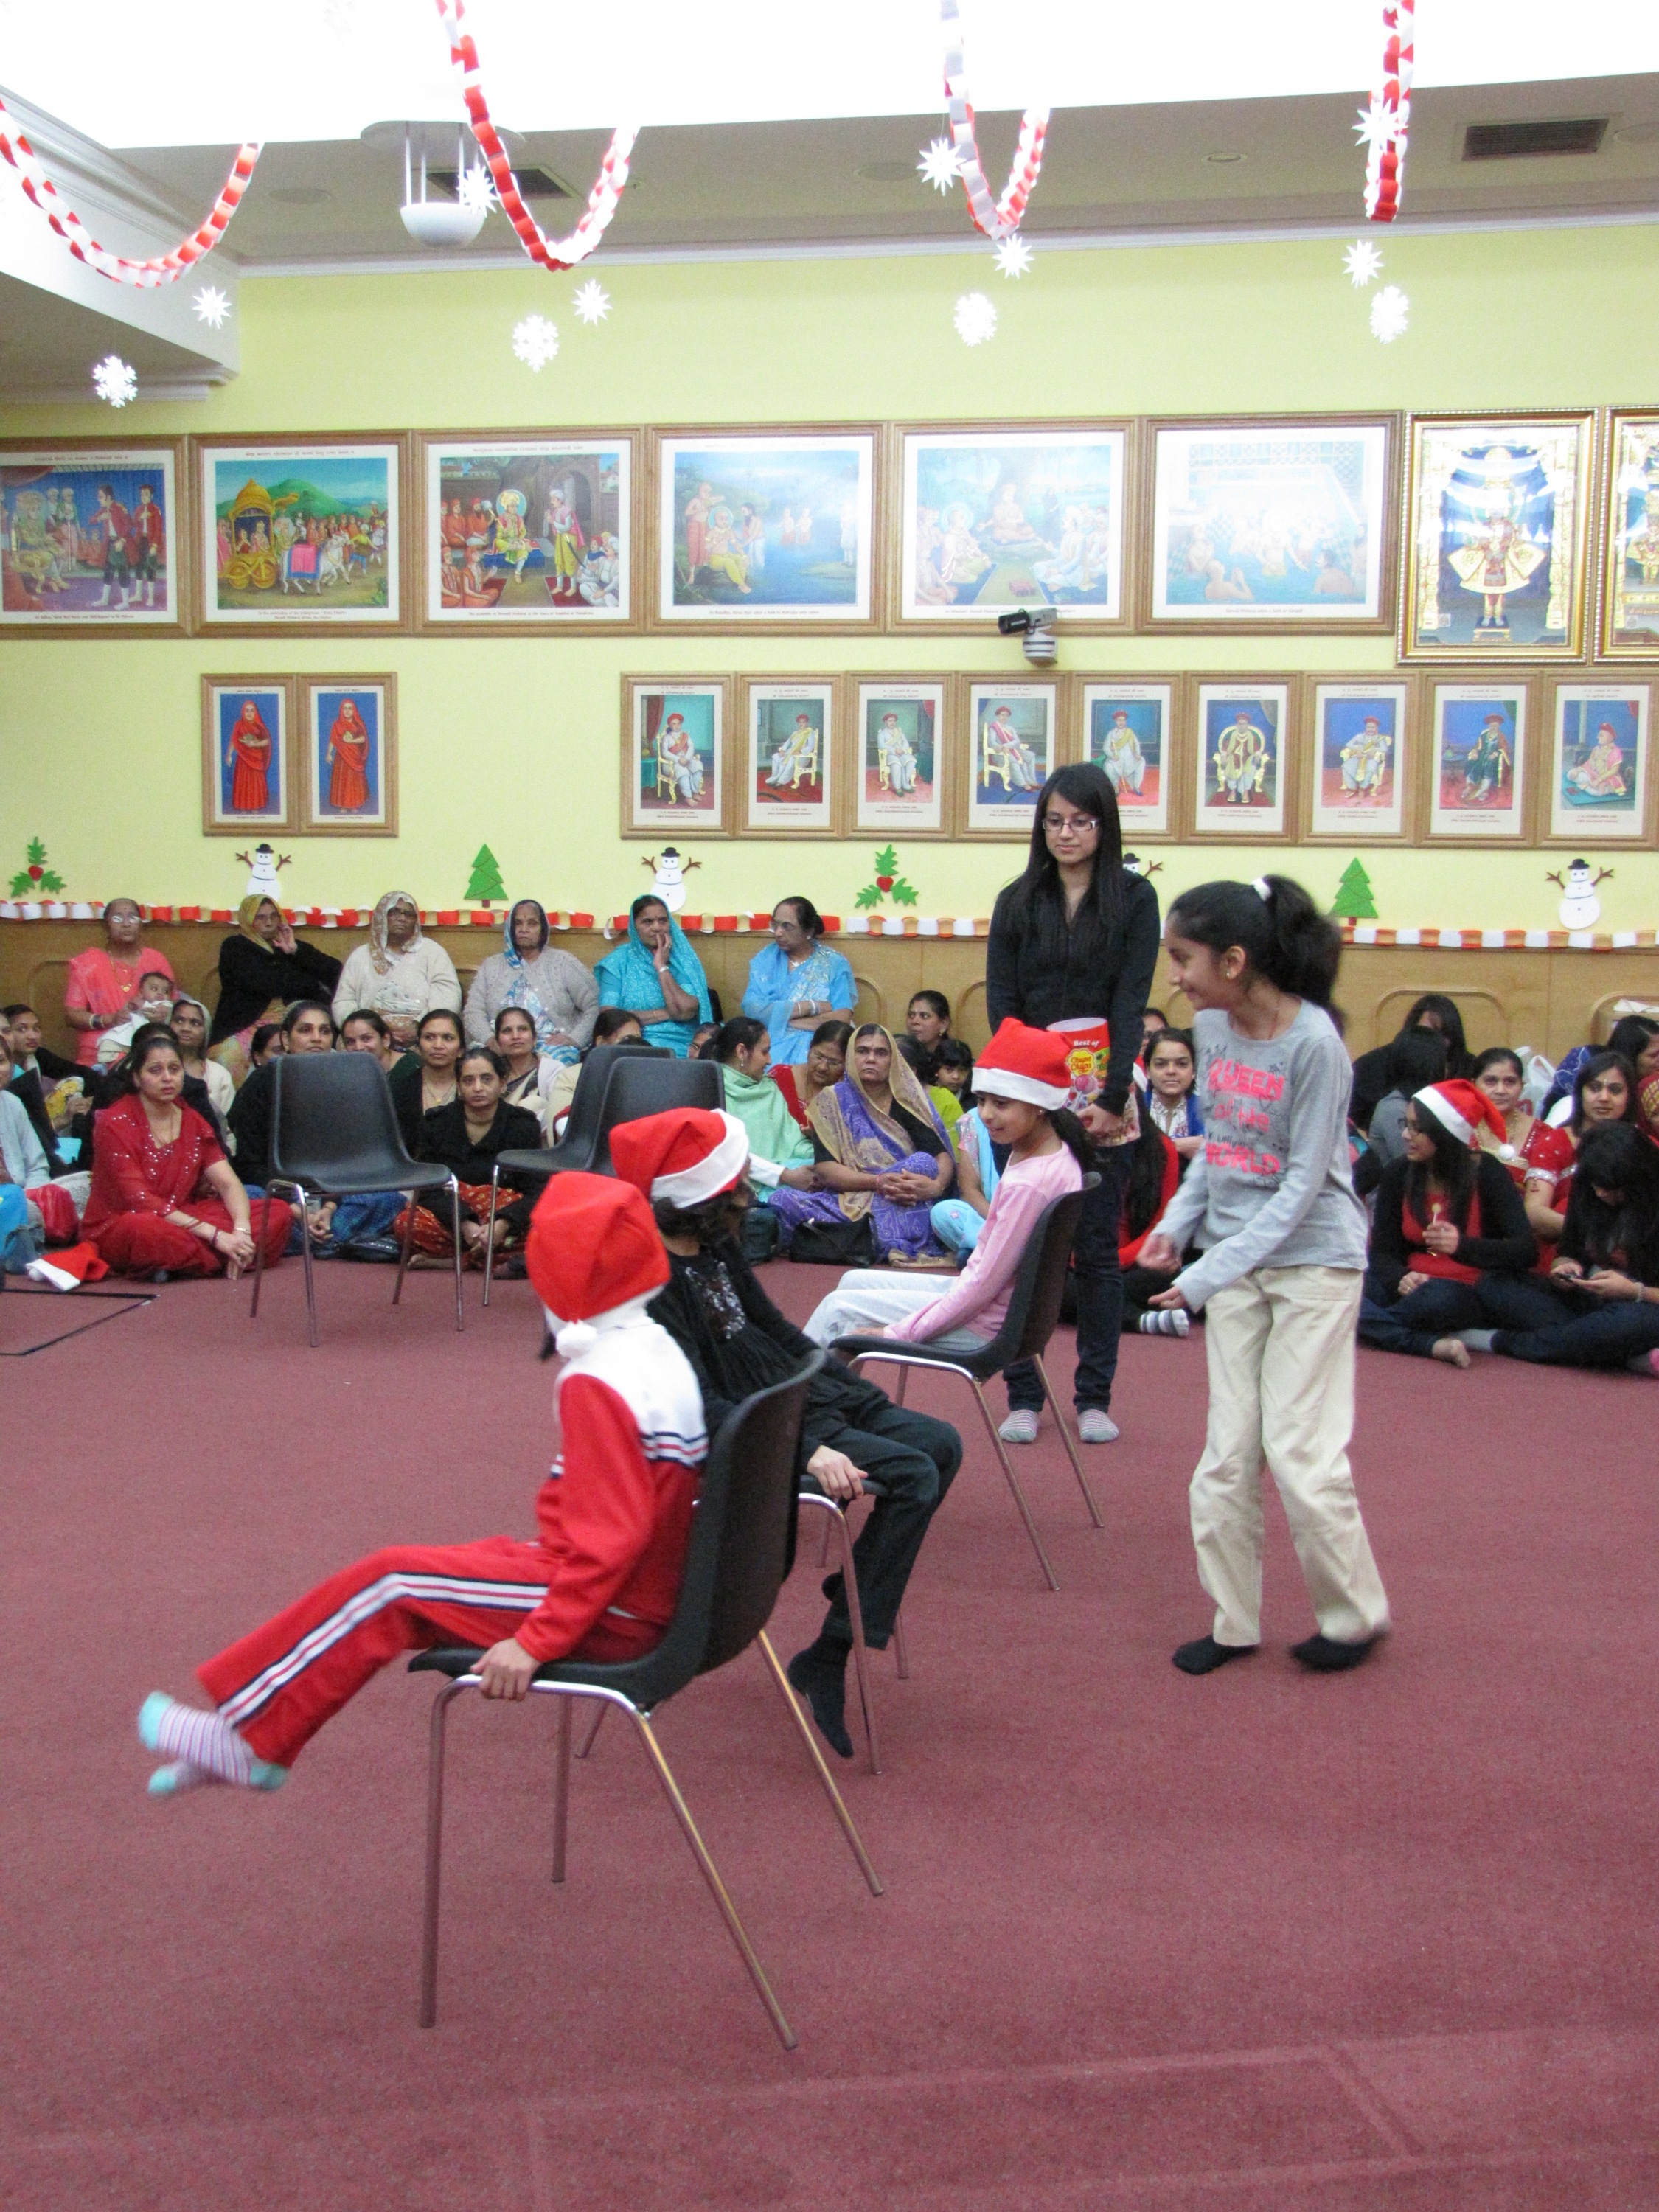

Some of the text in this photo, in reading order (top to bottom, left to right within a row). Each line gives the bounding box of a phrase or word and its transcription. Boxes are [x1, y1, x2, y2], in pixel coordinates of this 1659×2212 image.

[1091, 1040, 1099, 1048] of
[1207, 1057, 1285, 1102] QUEEN
[1205, 1141, 1280, 1176] WORLD
